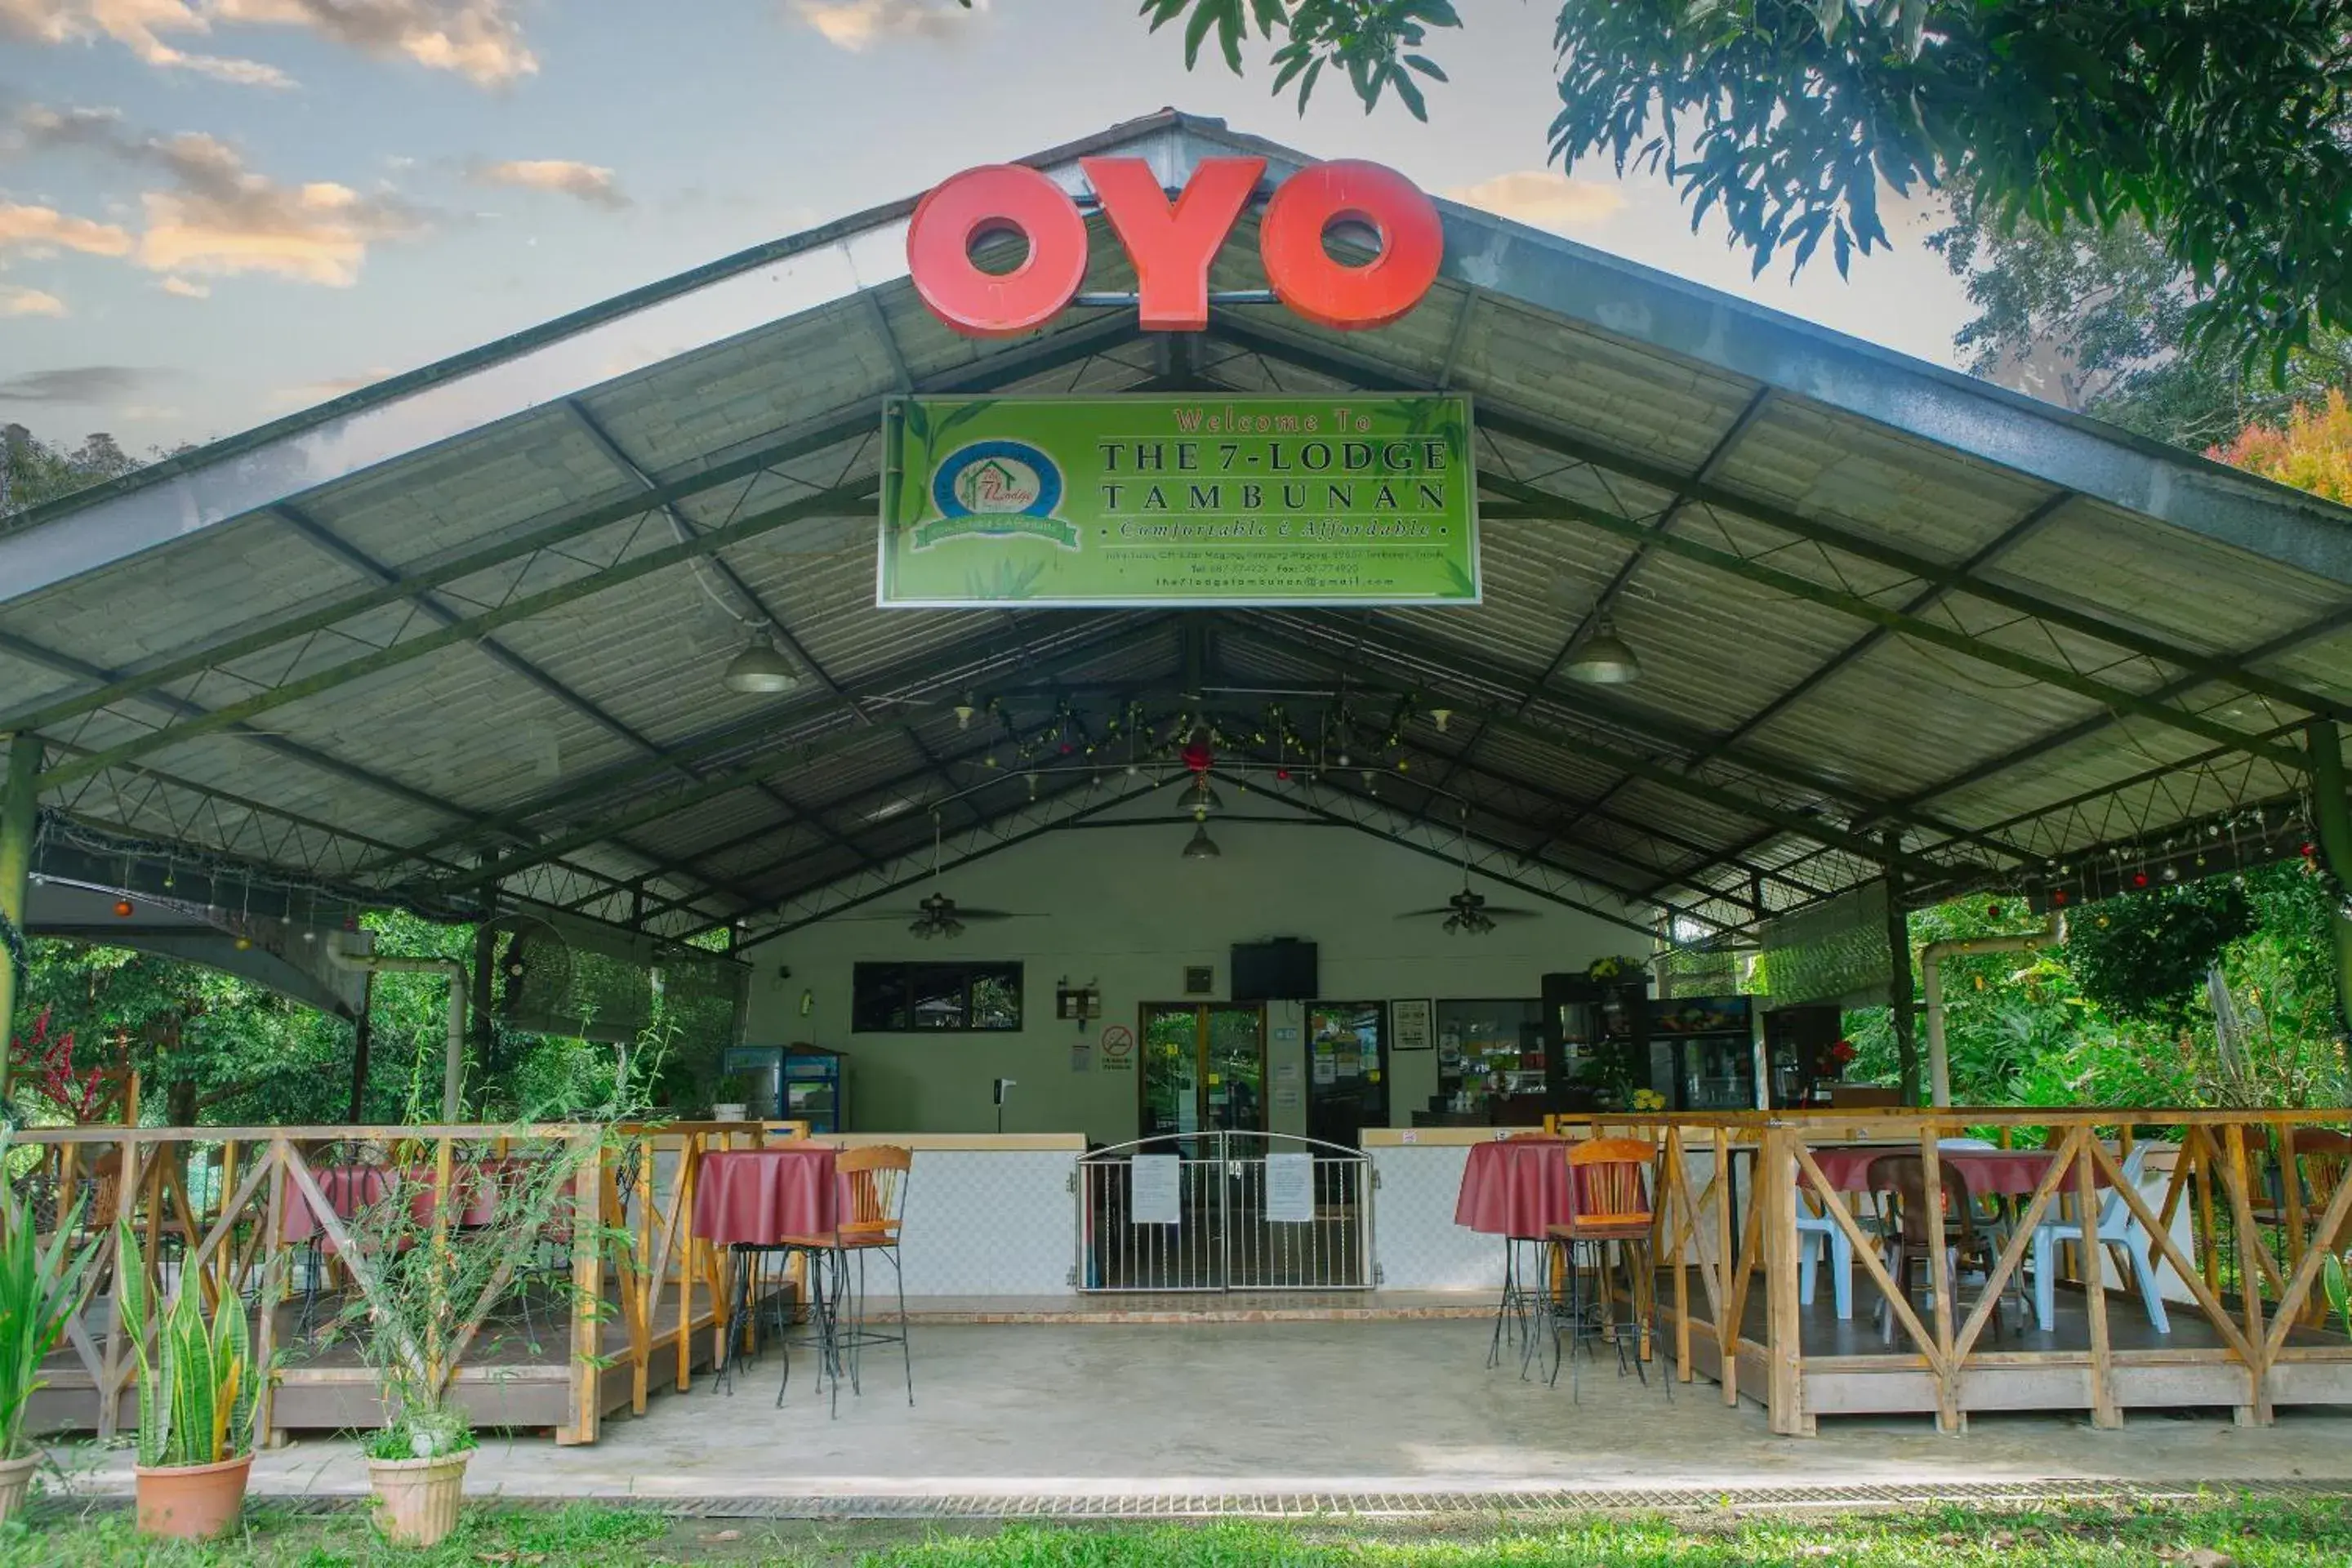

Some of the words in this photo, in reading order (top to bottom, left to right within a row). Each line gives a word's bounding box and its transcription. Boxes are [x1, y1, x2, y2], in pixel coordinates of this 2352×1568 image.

[906, 158, 1443, 335] OYO
[1174, 408, 1318, 433] Welcome
[1334, 408, 1372, 433] To
[1098, 442, 1198, 470] THE
[1218, 442, 1448, 471] 7-LODGE
[1102, 483, 1445, 510] TAMBUNAN
[1120, 519, 1267, 541] Comfortable
[1301, 519, 1430, 541] Affordable
